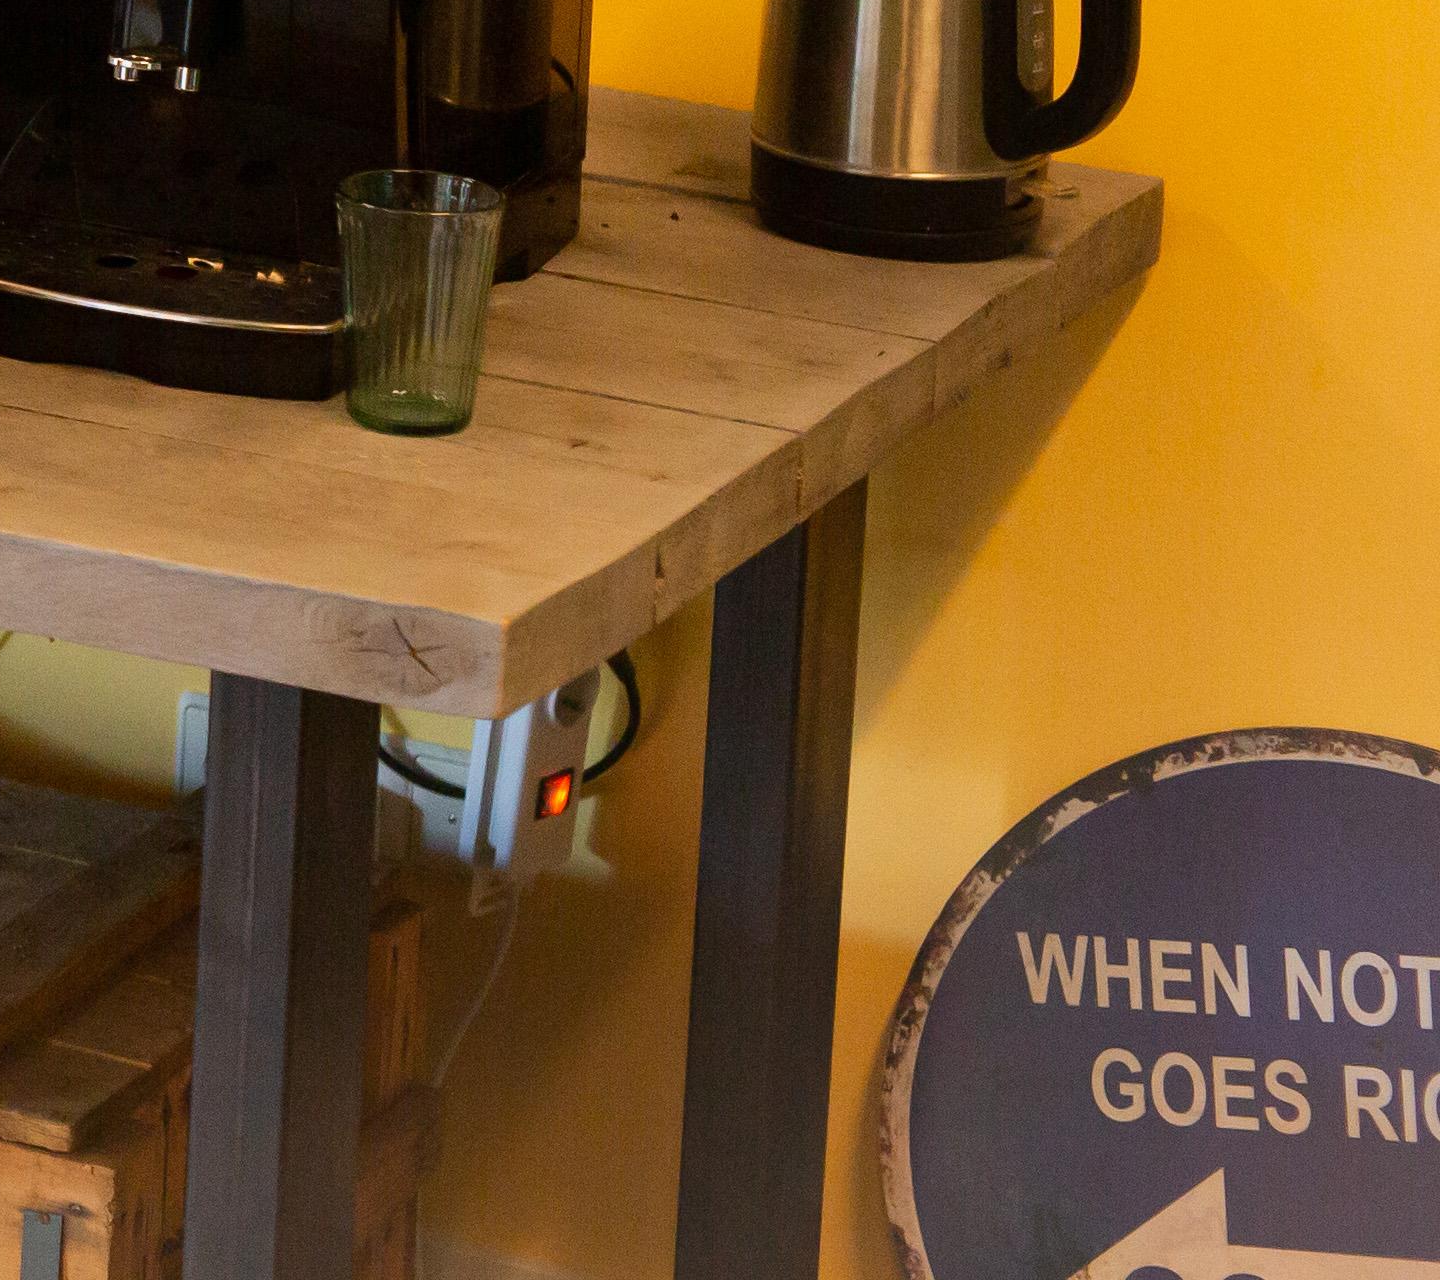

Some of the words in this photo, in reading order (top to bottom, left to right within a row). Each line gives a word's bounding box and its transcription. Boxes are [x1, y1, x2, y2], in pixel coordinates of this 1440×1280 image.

[1016, 931, 1253, 1018] WHEN
[1283, 947, 1440, 1030] NOT
[1091, 1047, 1312, 1135] GOES
